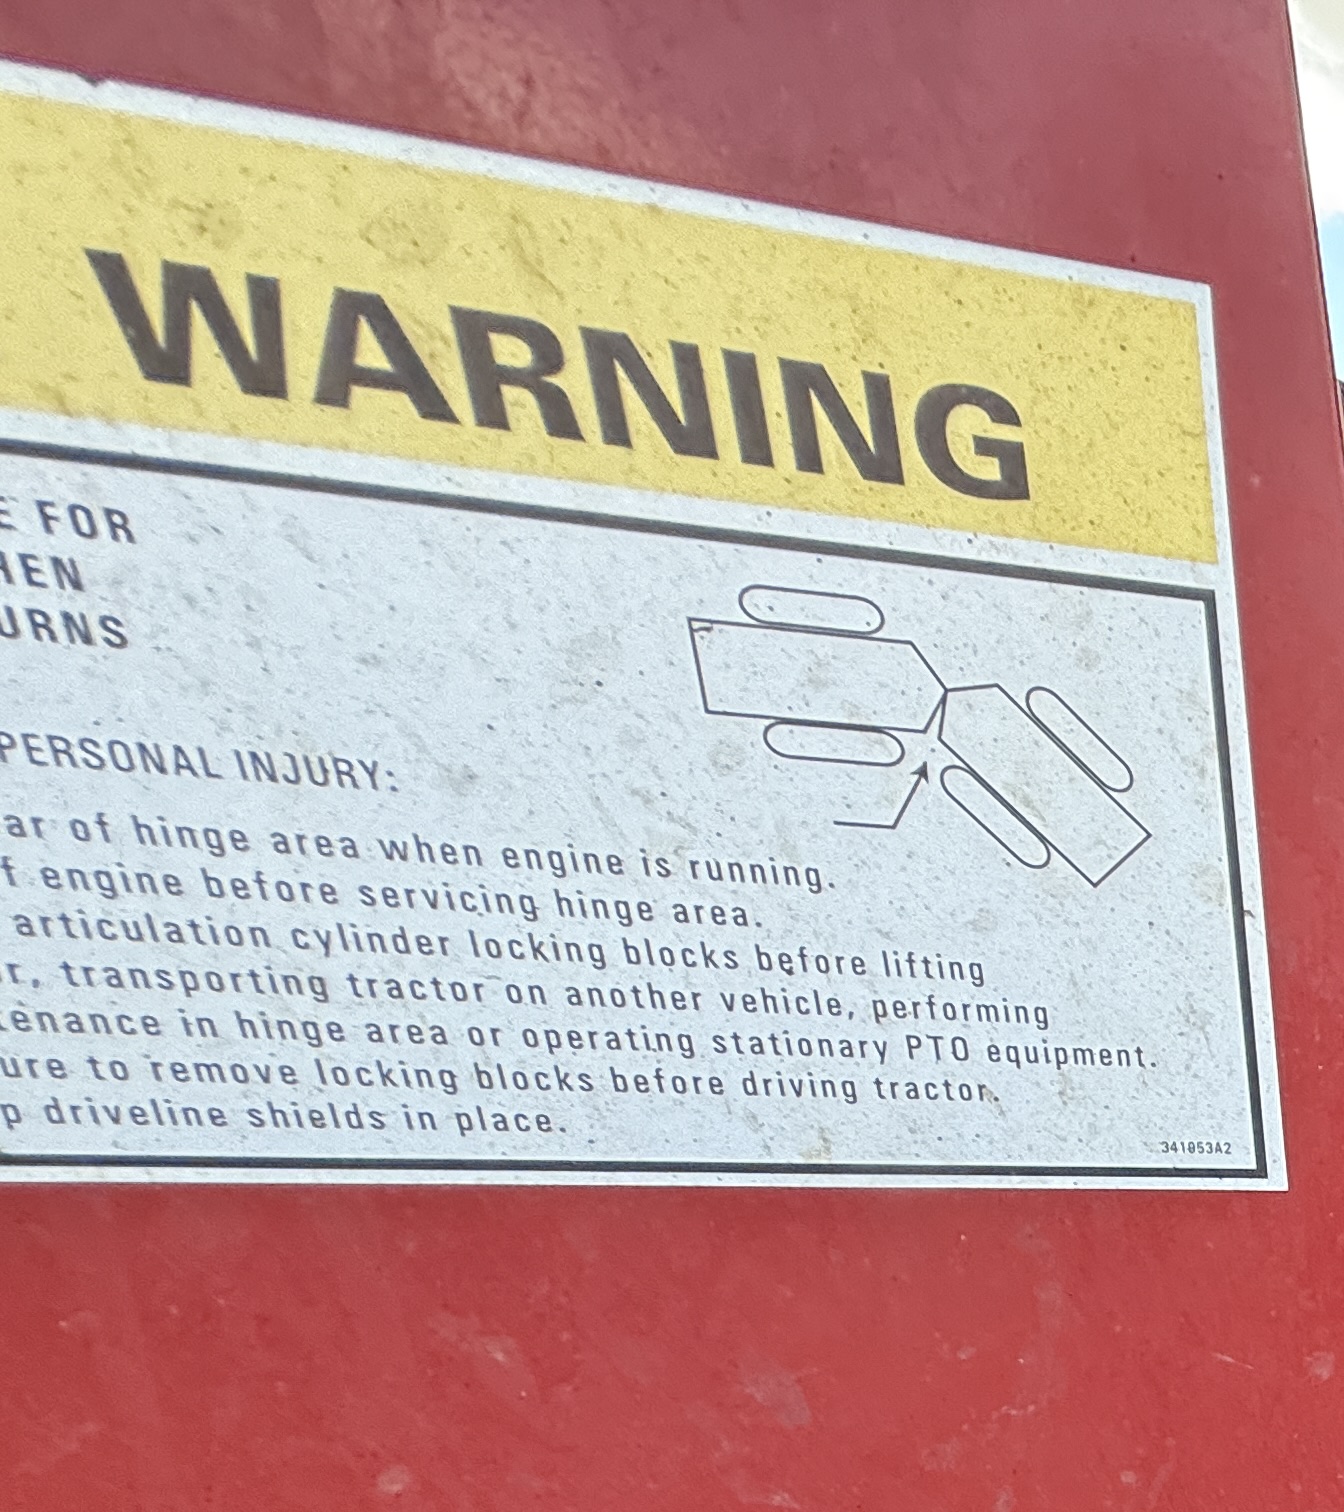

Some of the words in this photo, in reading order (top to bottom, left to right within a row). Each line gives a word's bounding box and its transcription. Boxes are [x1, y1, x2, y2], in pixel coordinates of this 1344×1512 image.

[84, 245, 1031, 500] WARNING
[34, 499, 137, 545] FOR
[0, 730, 225, 780] PERSONAL
[233, 748, 399, 793] INJURY:
[68, 811, 112, 844] of
[129, 814, 251, 858] hinge
[269, 831, 361, 860] area
[375, 832, 484, 867] when
[501, 842, 625, 879] engine
[639, 847, 673, 879] is
[688, 856, 836, 895] running.
[39, 861, 185, 901] engine
[199, 866, 340, 905] before
[357, 881, 541, 923] servicing
[552, 888, 655, 928] hinge
[671, 903, 763, 928] area.
[11, 908, 272, 949] articulation
[290, 922, 450, 959] cylinder
[467, 928, 607, 971] locking
[621, 936, 740, 973] blocks
[754, 943, 867, 977] before
[881, 949, 985, 988] lifting
[58, 960, 330, 1005] transporting
[345, 972, 485, 1003] tractor
[505, 983, 548, 1006] on
[564, 981, 702, 1012] another
[719, 986, 855, 1021] vehicle,
[871, 993, 1049, 1031] performing
[176, 1007, 220, 1038] in
[233, 1009, 346, 1049] hinge
[364, 1022, 449, 1046] area
[467, 1026, 502, 1048] or
[521, 1024, 696, 1064] operating
[711, 1029, 888, 1066] stationary
[905, 1033, 970, 1065] PTO
[986, 1037, 1157, 1071] equipment.
[85, 1055, 130, 1082] to
[149, 1061, 300, 1086] remove
[313, 1057, 459, 1096] locking
[472, 1061, 595, 1093] blocks
[608, 1065, 725, 1096] before
[741, 1069, 858, 1105] driving
[872, 1076, 1000, 1105] tractor.
[43, 1096, 229, 1128] driveline
[246, 1100, 387, 1131] shields
[400, 1103, 438, 1131] in
[453, 1104, 567, 1138] place.
